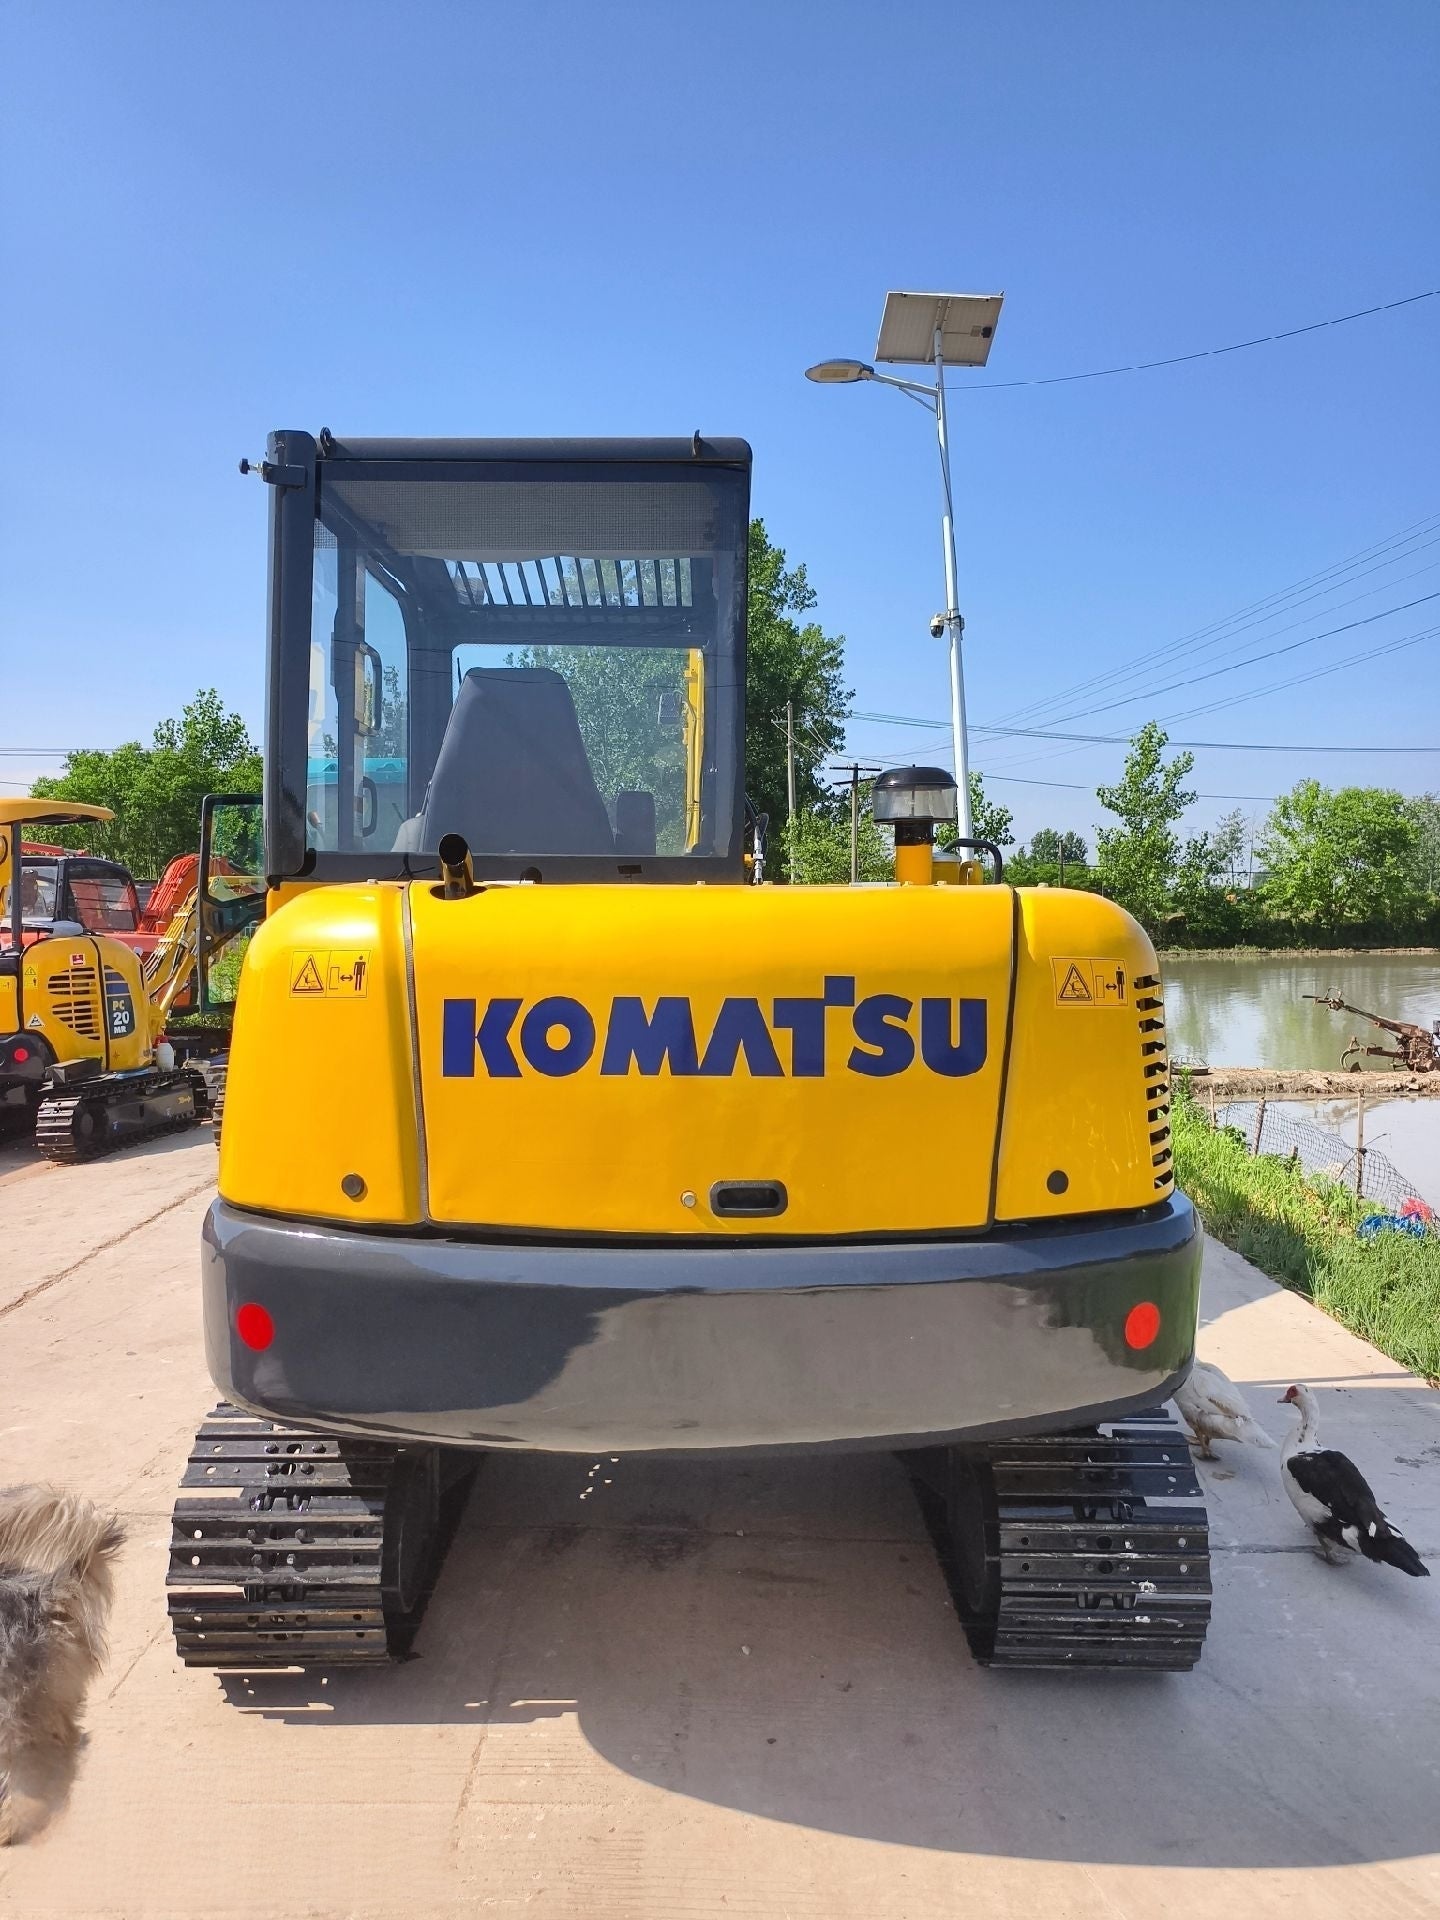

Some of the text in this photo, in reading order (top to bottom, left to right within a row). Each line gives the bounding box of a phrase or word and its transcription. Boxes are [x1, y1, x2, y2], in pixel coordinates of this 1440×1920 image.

[112, 1000, 125, 1011] PC
[113, 1010, 130, 1026] 20
[113, 1025, 127, 1034] MR
[443, 975, 988, 1077] KOMATSU
